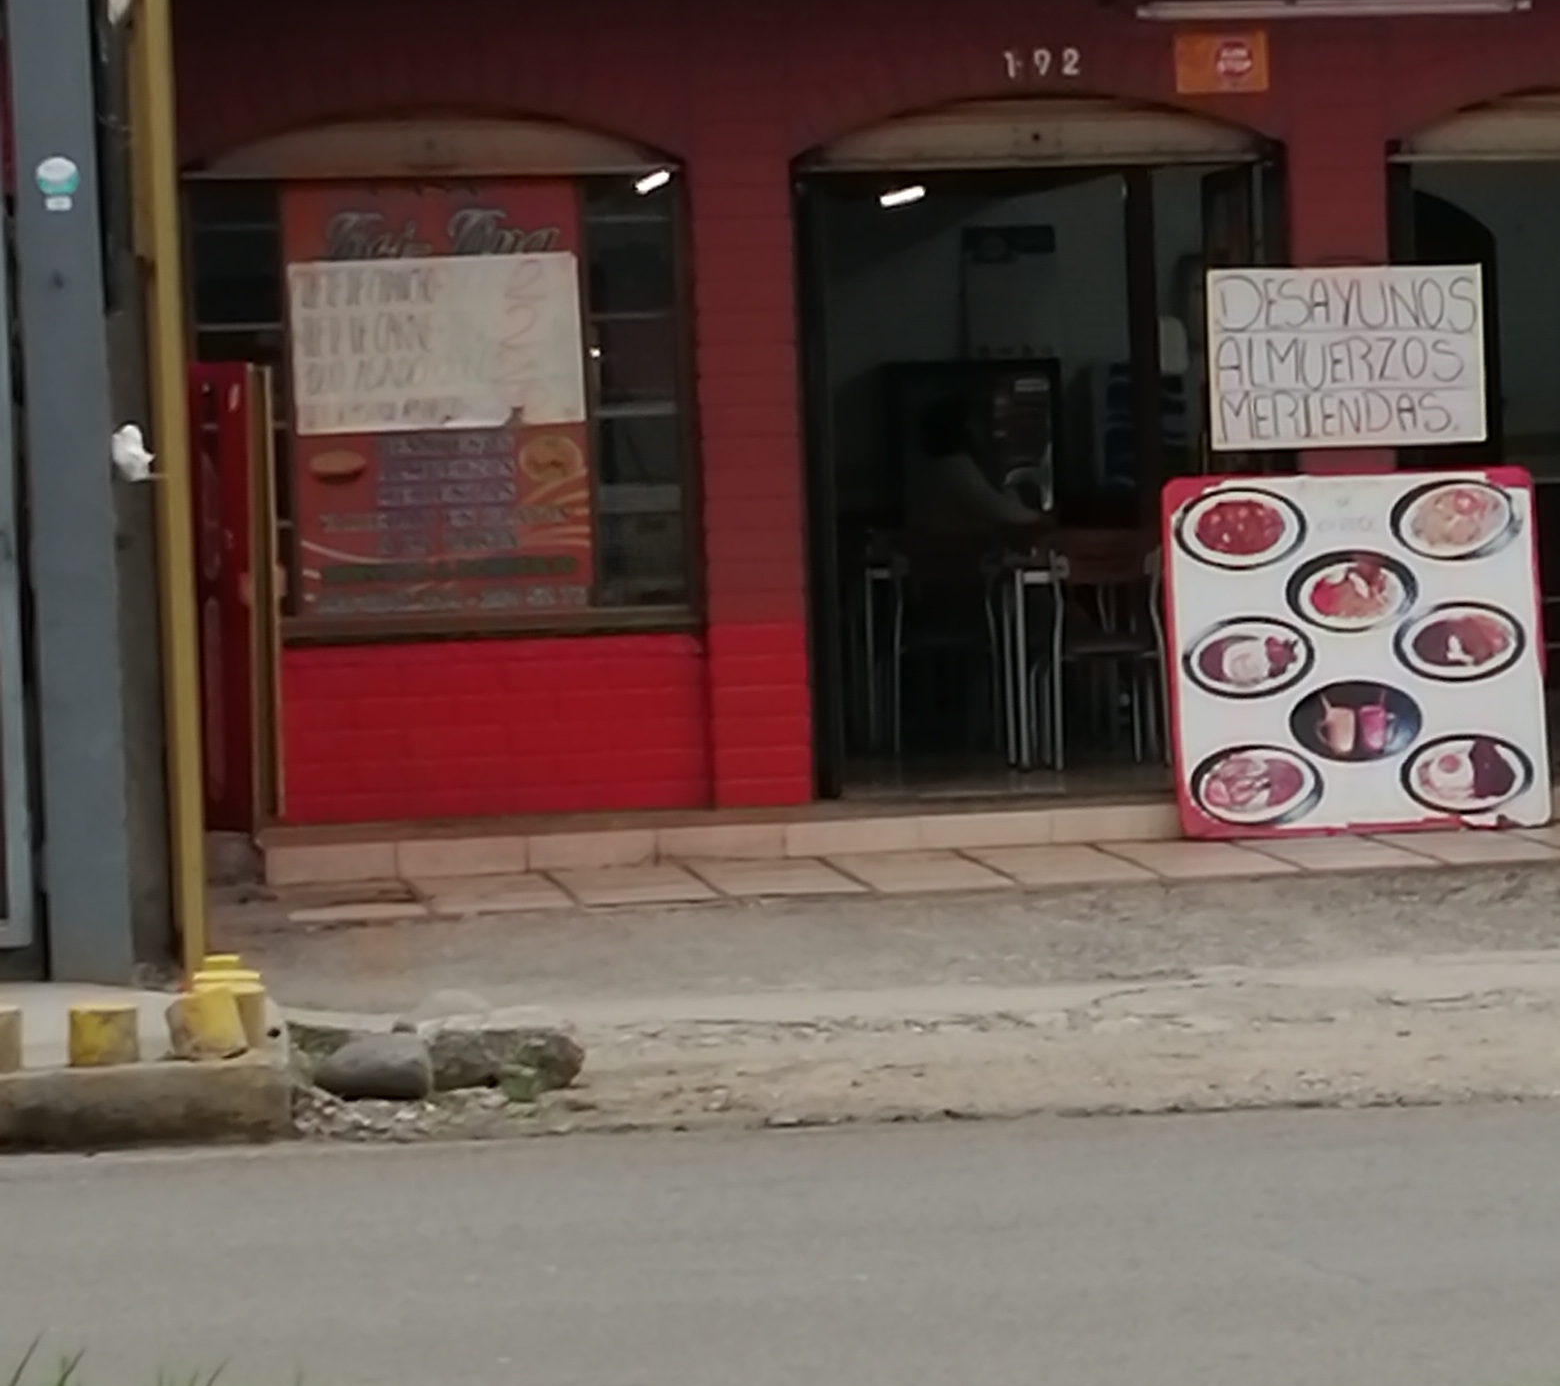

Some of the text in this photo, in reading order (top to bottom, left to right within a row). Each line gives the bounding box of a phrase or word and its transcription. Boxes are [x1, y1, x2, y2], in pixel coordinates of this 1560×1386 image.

[1004, 48, 1081, 78] 192
[1212, 275, 1475, 334] DESAYUNOS
[1216, 336, 1464, 390] ALMUERZOS
